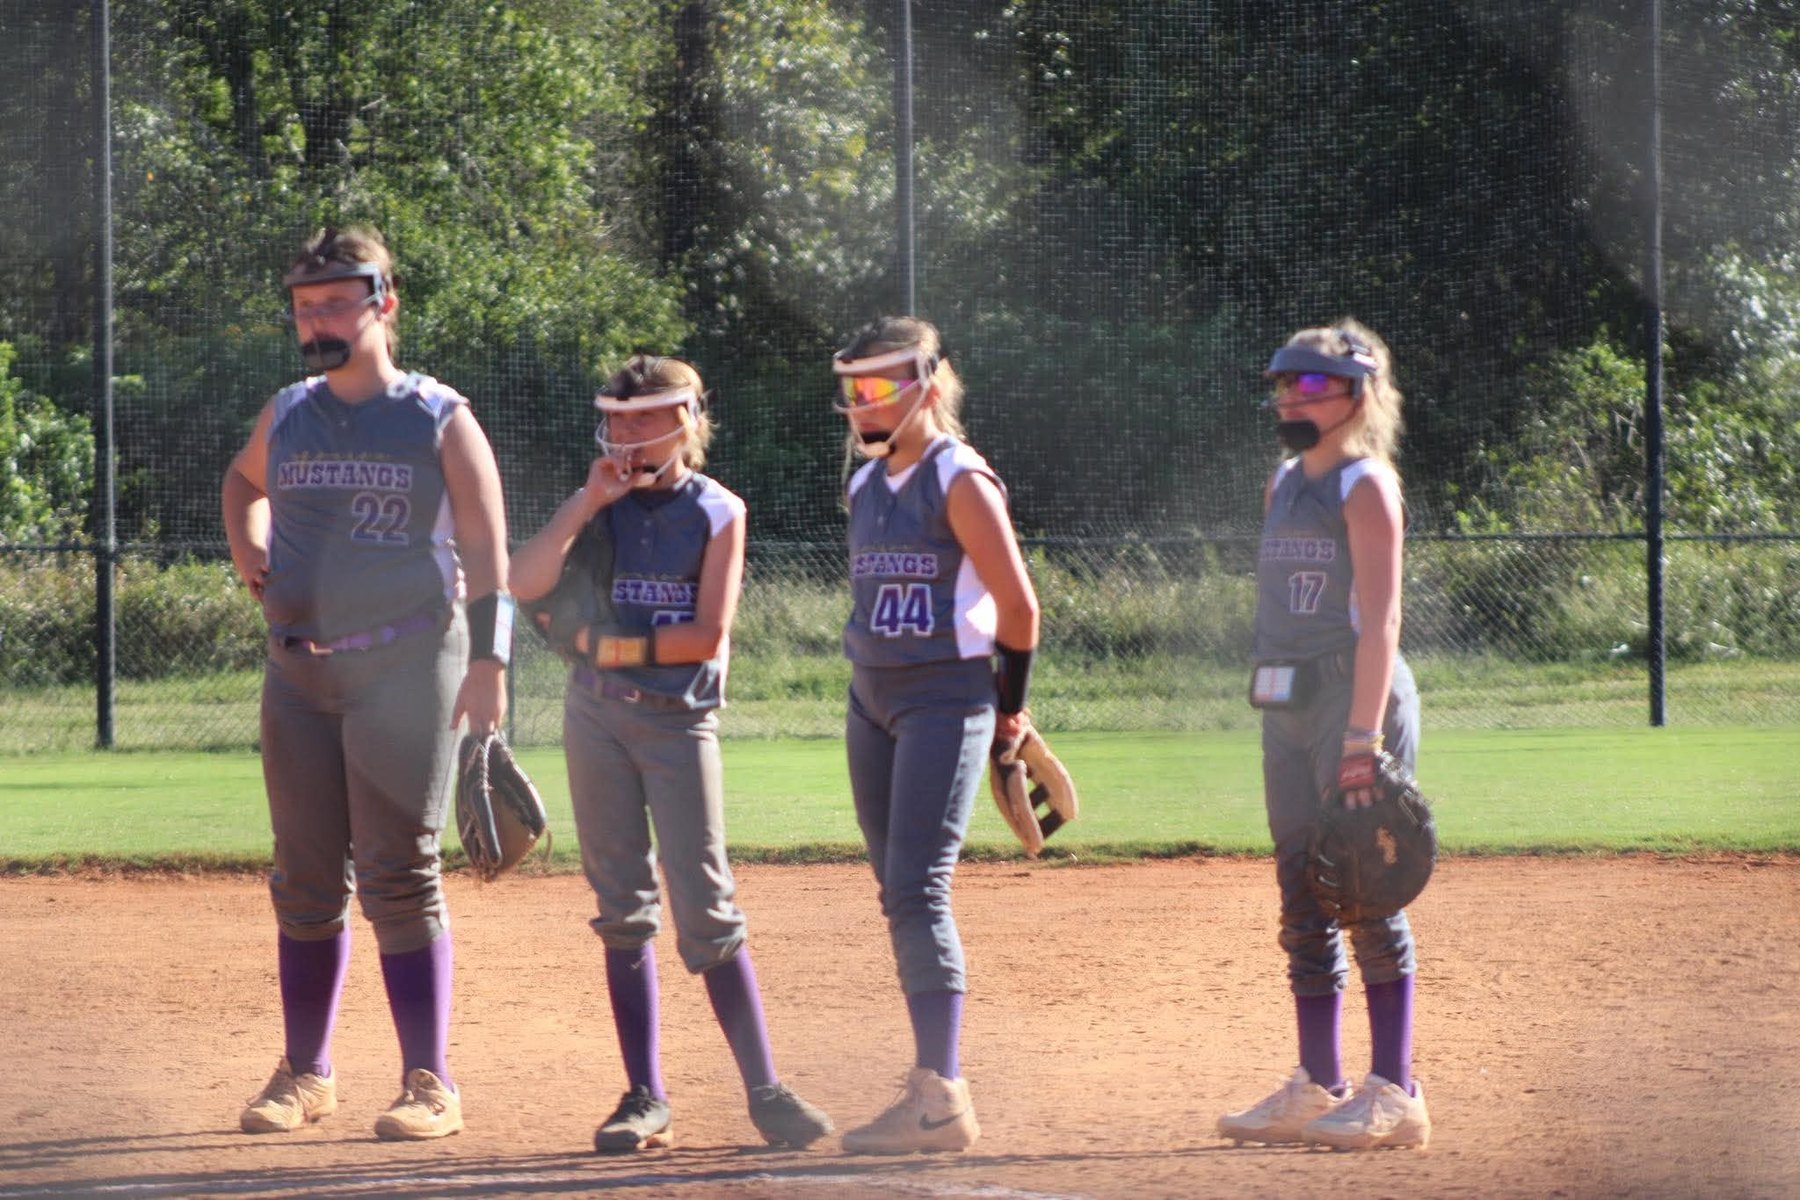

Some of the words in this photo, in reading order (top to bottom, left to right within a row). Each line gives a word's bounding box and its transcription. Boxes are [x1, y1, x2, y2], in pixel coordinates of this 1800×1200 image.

[278, 461, 413, 491] MUSTANGS
[352, 491, 410, 545] 22
[870, 583, 935, 637] 44
[1288, 572, 1326, 614] 17
